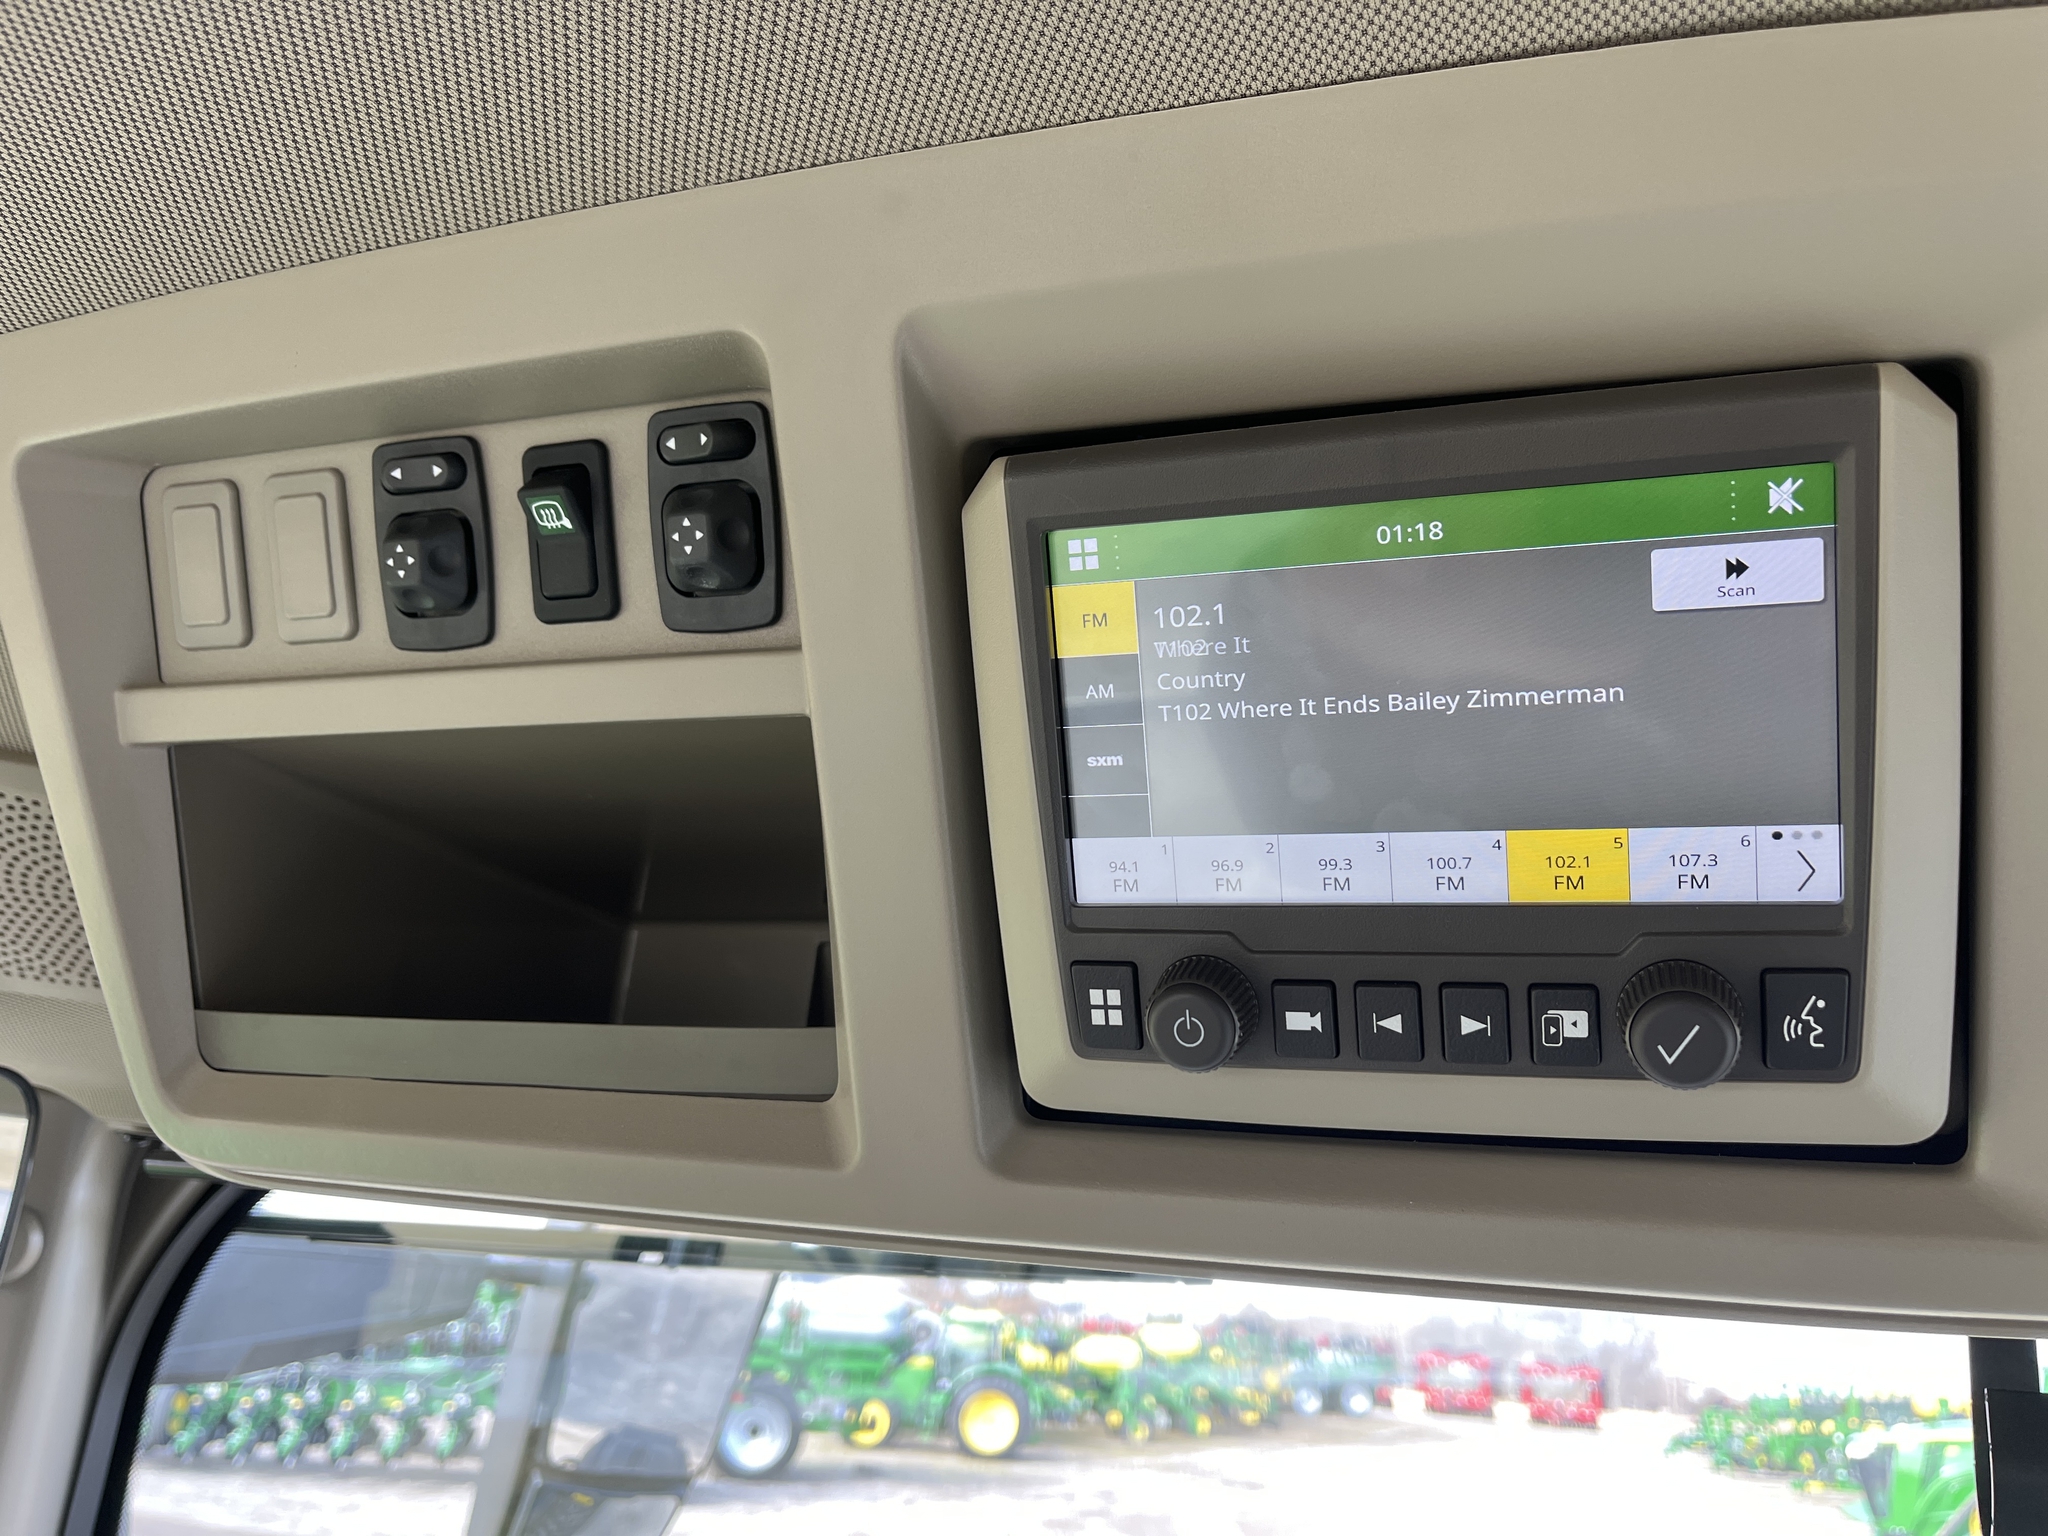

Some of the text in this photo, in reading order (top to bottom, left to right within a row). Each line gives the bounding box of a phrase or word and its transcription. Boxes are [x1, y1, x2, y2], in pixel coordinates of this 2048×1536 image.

[1376, 521, 1444, 545] 01:18
[1716, 584, 1756, 598] Scan
[1082, 613, 1109, 628] FM
[1153, 603, 1225, 629] 102.1
[1233, 636, 1252, 654] It
[1157, 671, 1246, 692] Country
[1085, 683, 1115, 700] AM
[1158, 683, 1625, 722] T102 Where It Ends Bailey Zimmerman
[1265, 842, 1275, 855] 2
[1375, 840, 1386, 853] 3
[1491, 838, 1503, 851] 4
[1613, 836, 1624, 850] 5
[1740, 835, 1751, 848] 6
[1161, 844, 1168, 855] 1
[1108, 860, 1139, 874] 94.1
[1210, 859, 1244, 873] 96.9
[1318, 857, 1353, 871] 99.3
[1427, 857, 1472, 871] 100.7
[1544, 855, 1592, 869] 102.1
[1668, 854, 1719, 868] 107.3
[1113, 879, 1139, 893] FM
[1215, 878, 1242, 892] FM
[1322, 877, 1351, 892] FM
[1435, 876, 1466, 891] FM
[1553, 875, 1585, 891] FM
[1677, 874, 1711, 890] FM
